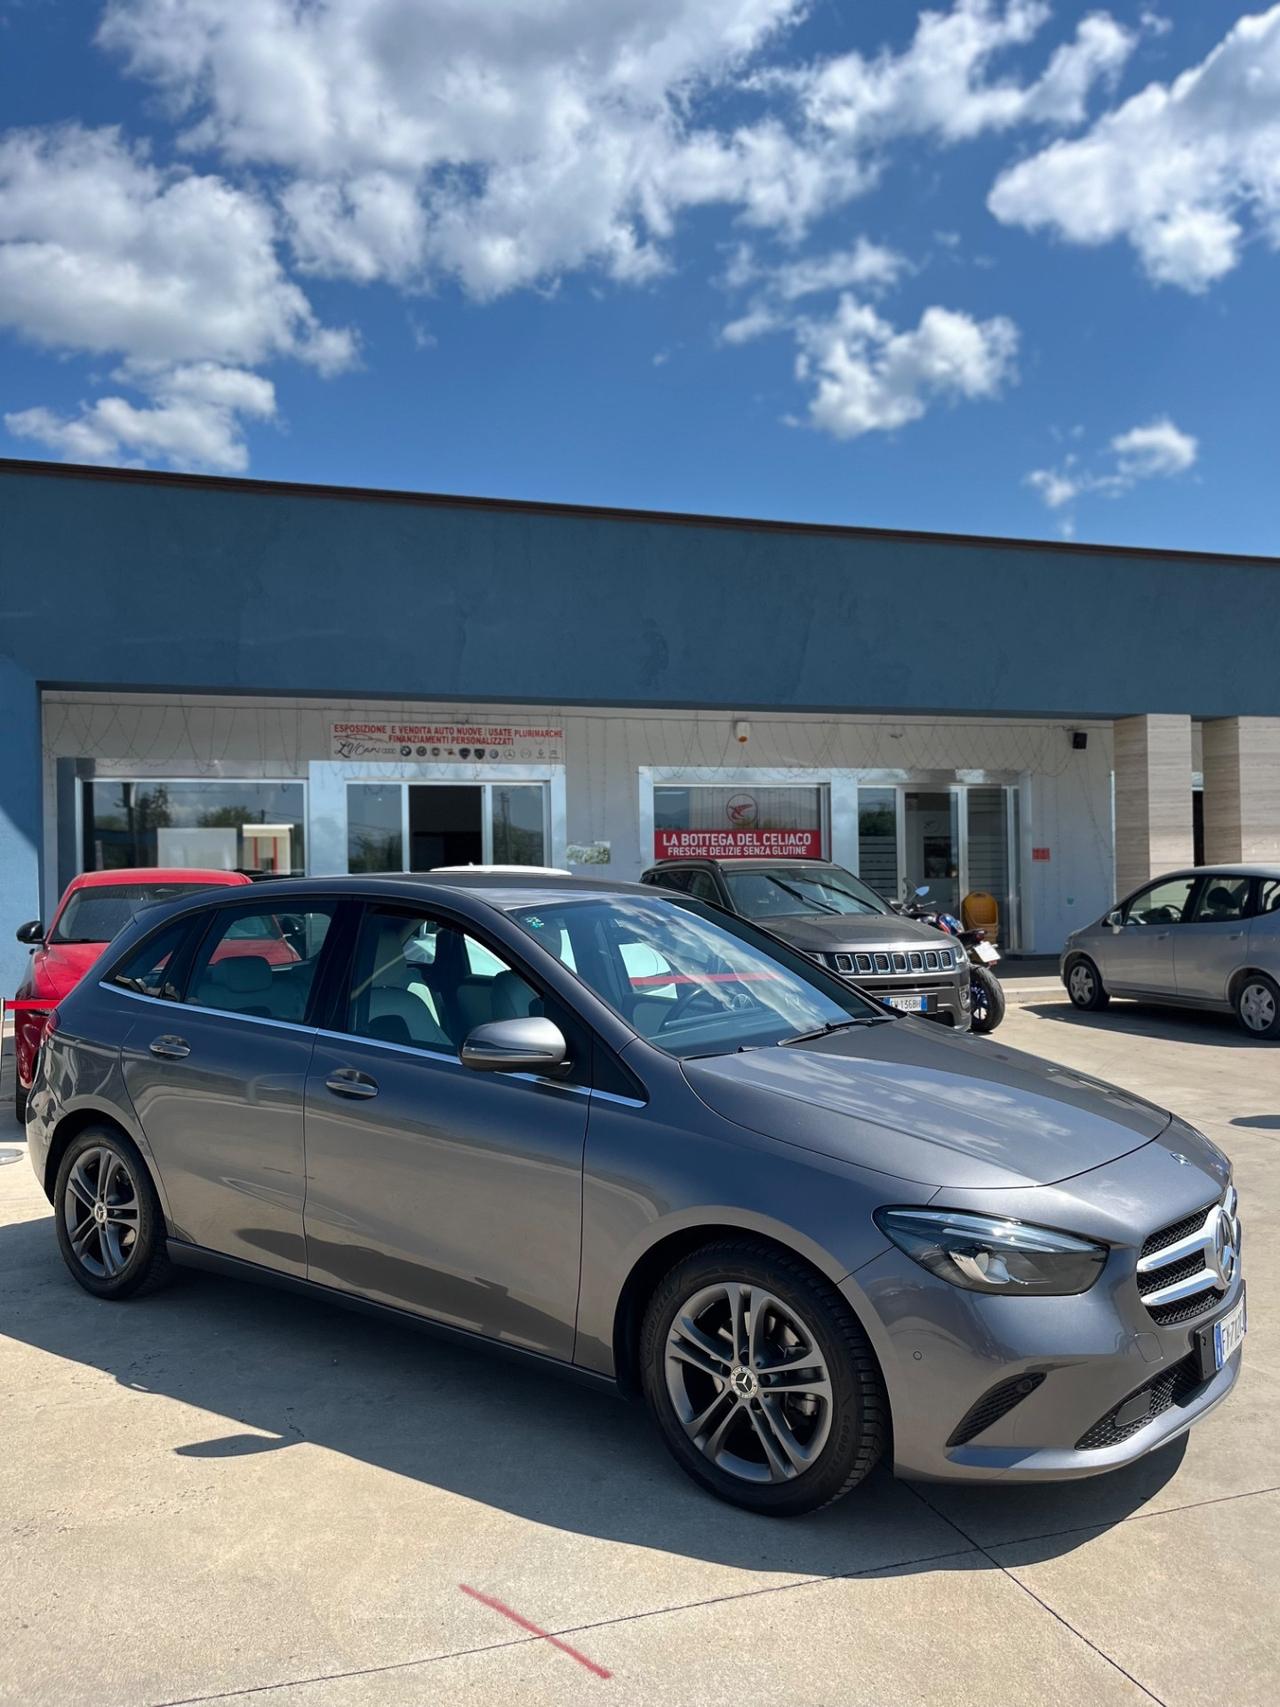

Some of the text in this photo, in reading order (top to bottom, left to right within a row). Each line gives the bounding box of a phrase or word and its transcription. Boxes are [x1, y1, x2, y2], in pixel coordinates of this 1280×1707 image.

[334, 724, 563, 738] ESPOSIZIONE E VENDITA AUTO NUOVE USATE PLURIMARCHE
[388, 735, 514, 746] FINANZIAMENTI PERSONALIZZATI
[663, 833, 811, 846] LA BOTTEGA DEL CELIACO
[668, 846, 807, 856] FRESCHE DELIZIE SENZA GLUTINE
